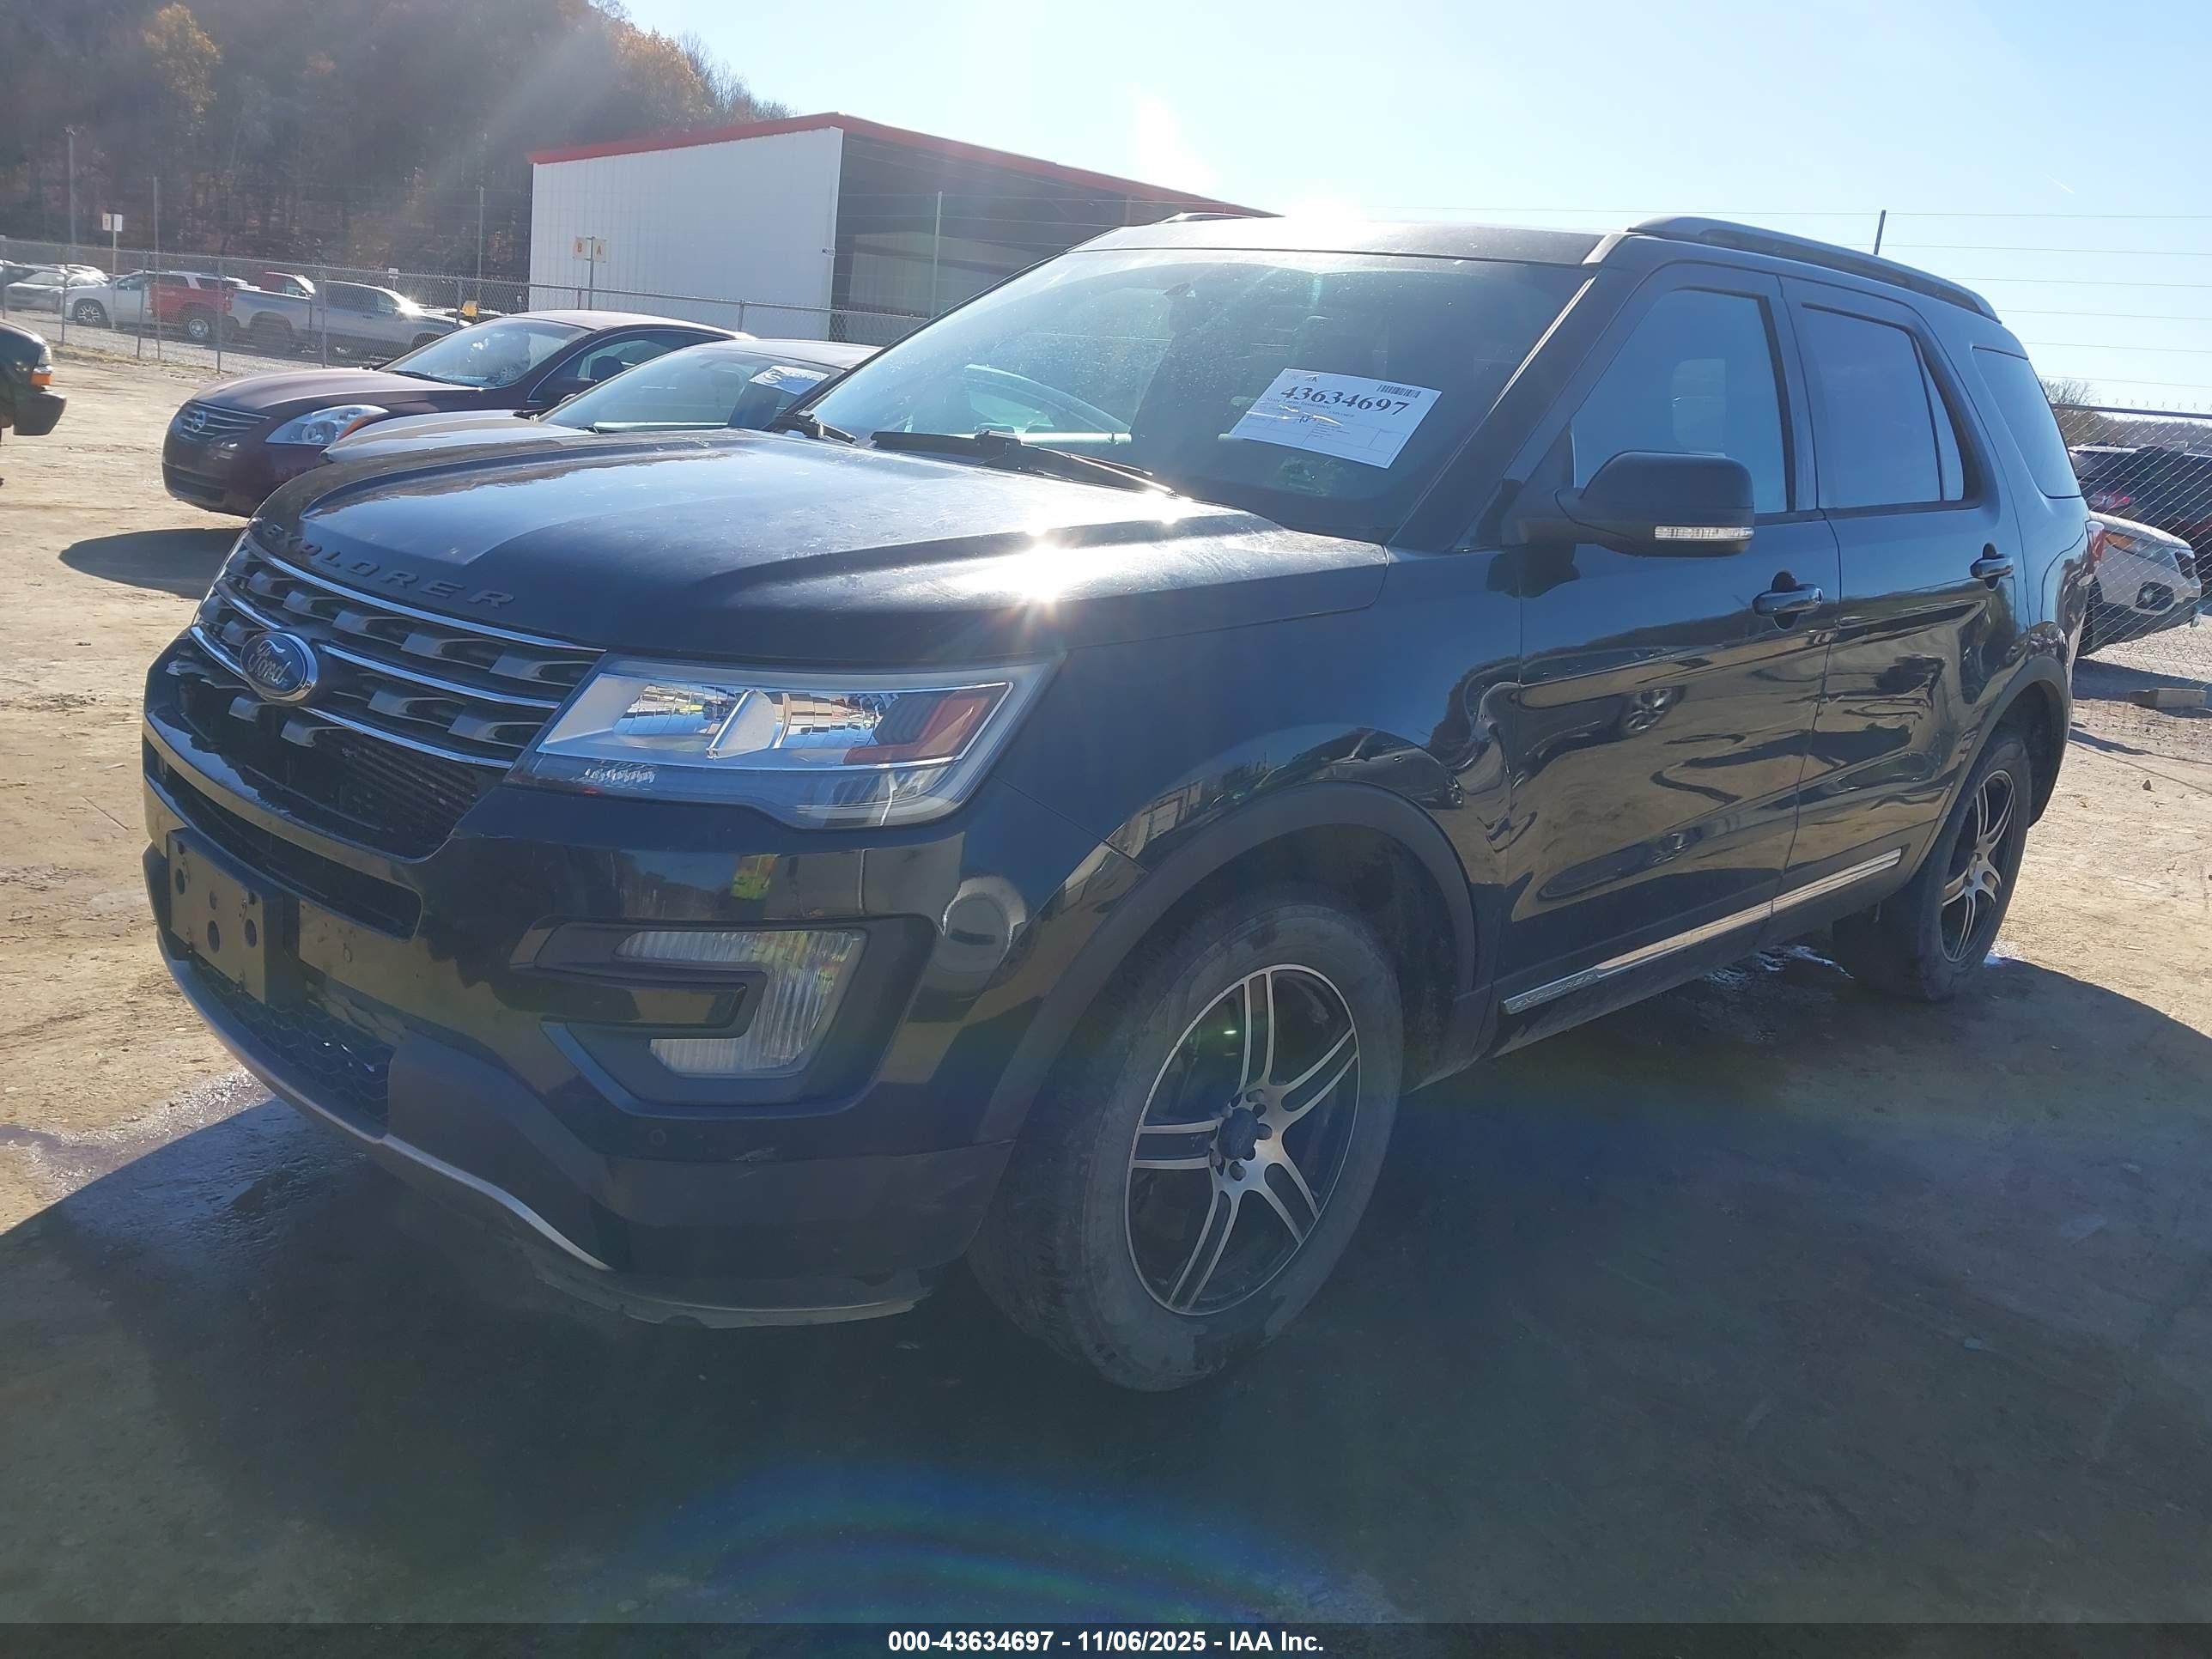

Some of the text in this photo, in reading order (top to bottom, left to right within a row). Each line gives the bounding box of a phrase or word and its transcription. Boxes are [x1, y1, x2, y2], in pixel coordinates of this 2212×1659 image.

[596, 245, 602, 255] A
[1280, 386, 1410, 416] 43634697
[262, 522, 516, 610] EXPLORER
[247, 639, 293, 685] Ford
